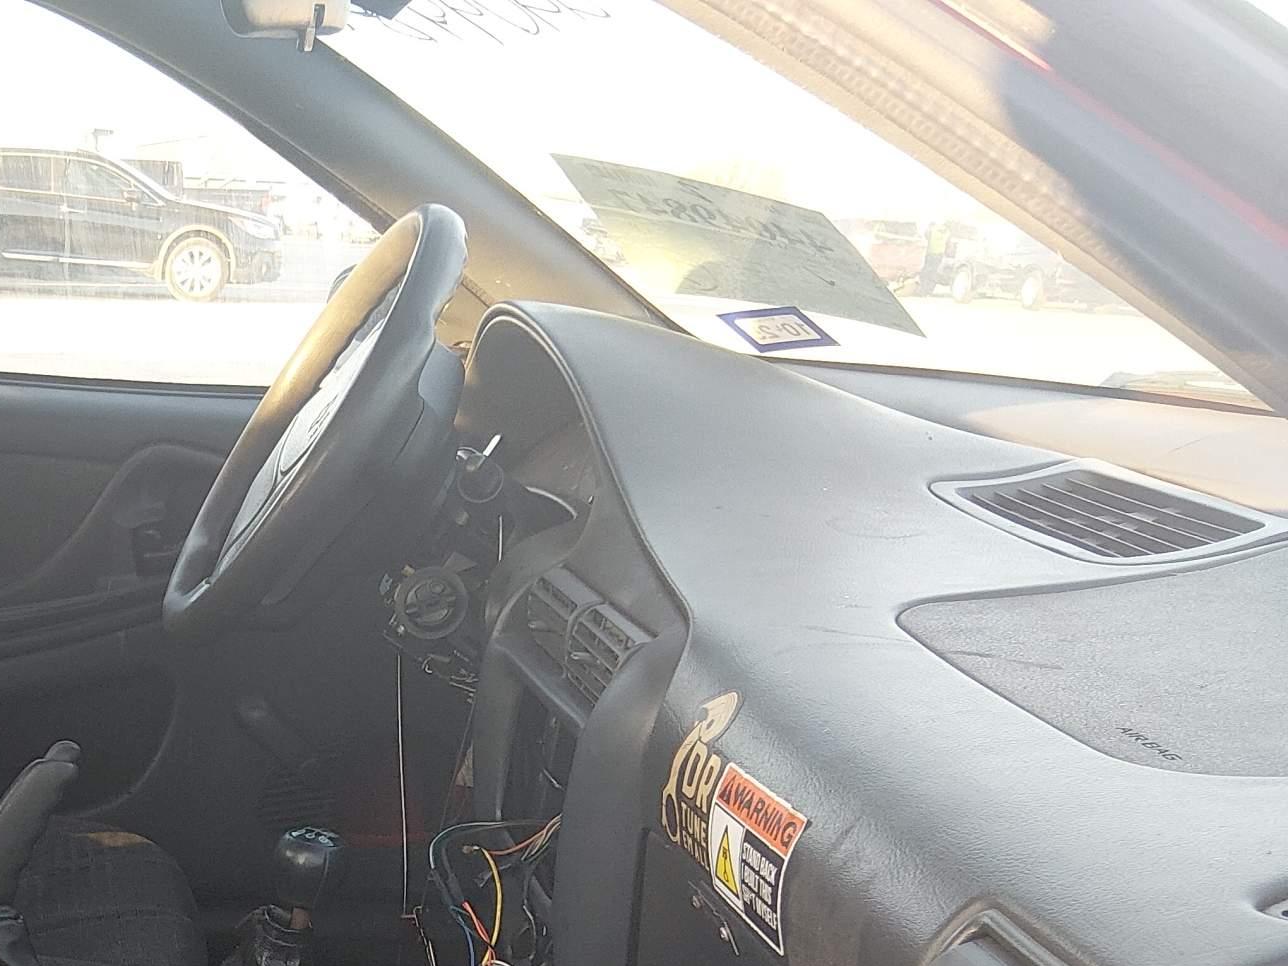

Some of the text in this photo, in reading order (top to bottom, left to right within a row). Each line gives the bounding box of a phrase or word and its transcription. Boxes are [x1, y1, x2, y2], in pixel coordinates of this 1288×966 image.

[1115, 727, 1183, 761] AIRBAG
[681, 802, 708, 847] TUNE
[732, 782, 797, 849] WARNING
[743, 842, 778, 887] STAND BACK
[744, 864, 759, 893] BUILT
[759, 877, 772, 905] THIS
[755, 895, 777, 931] MYSELF
